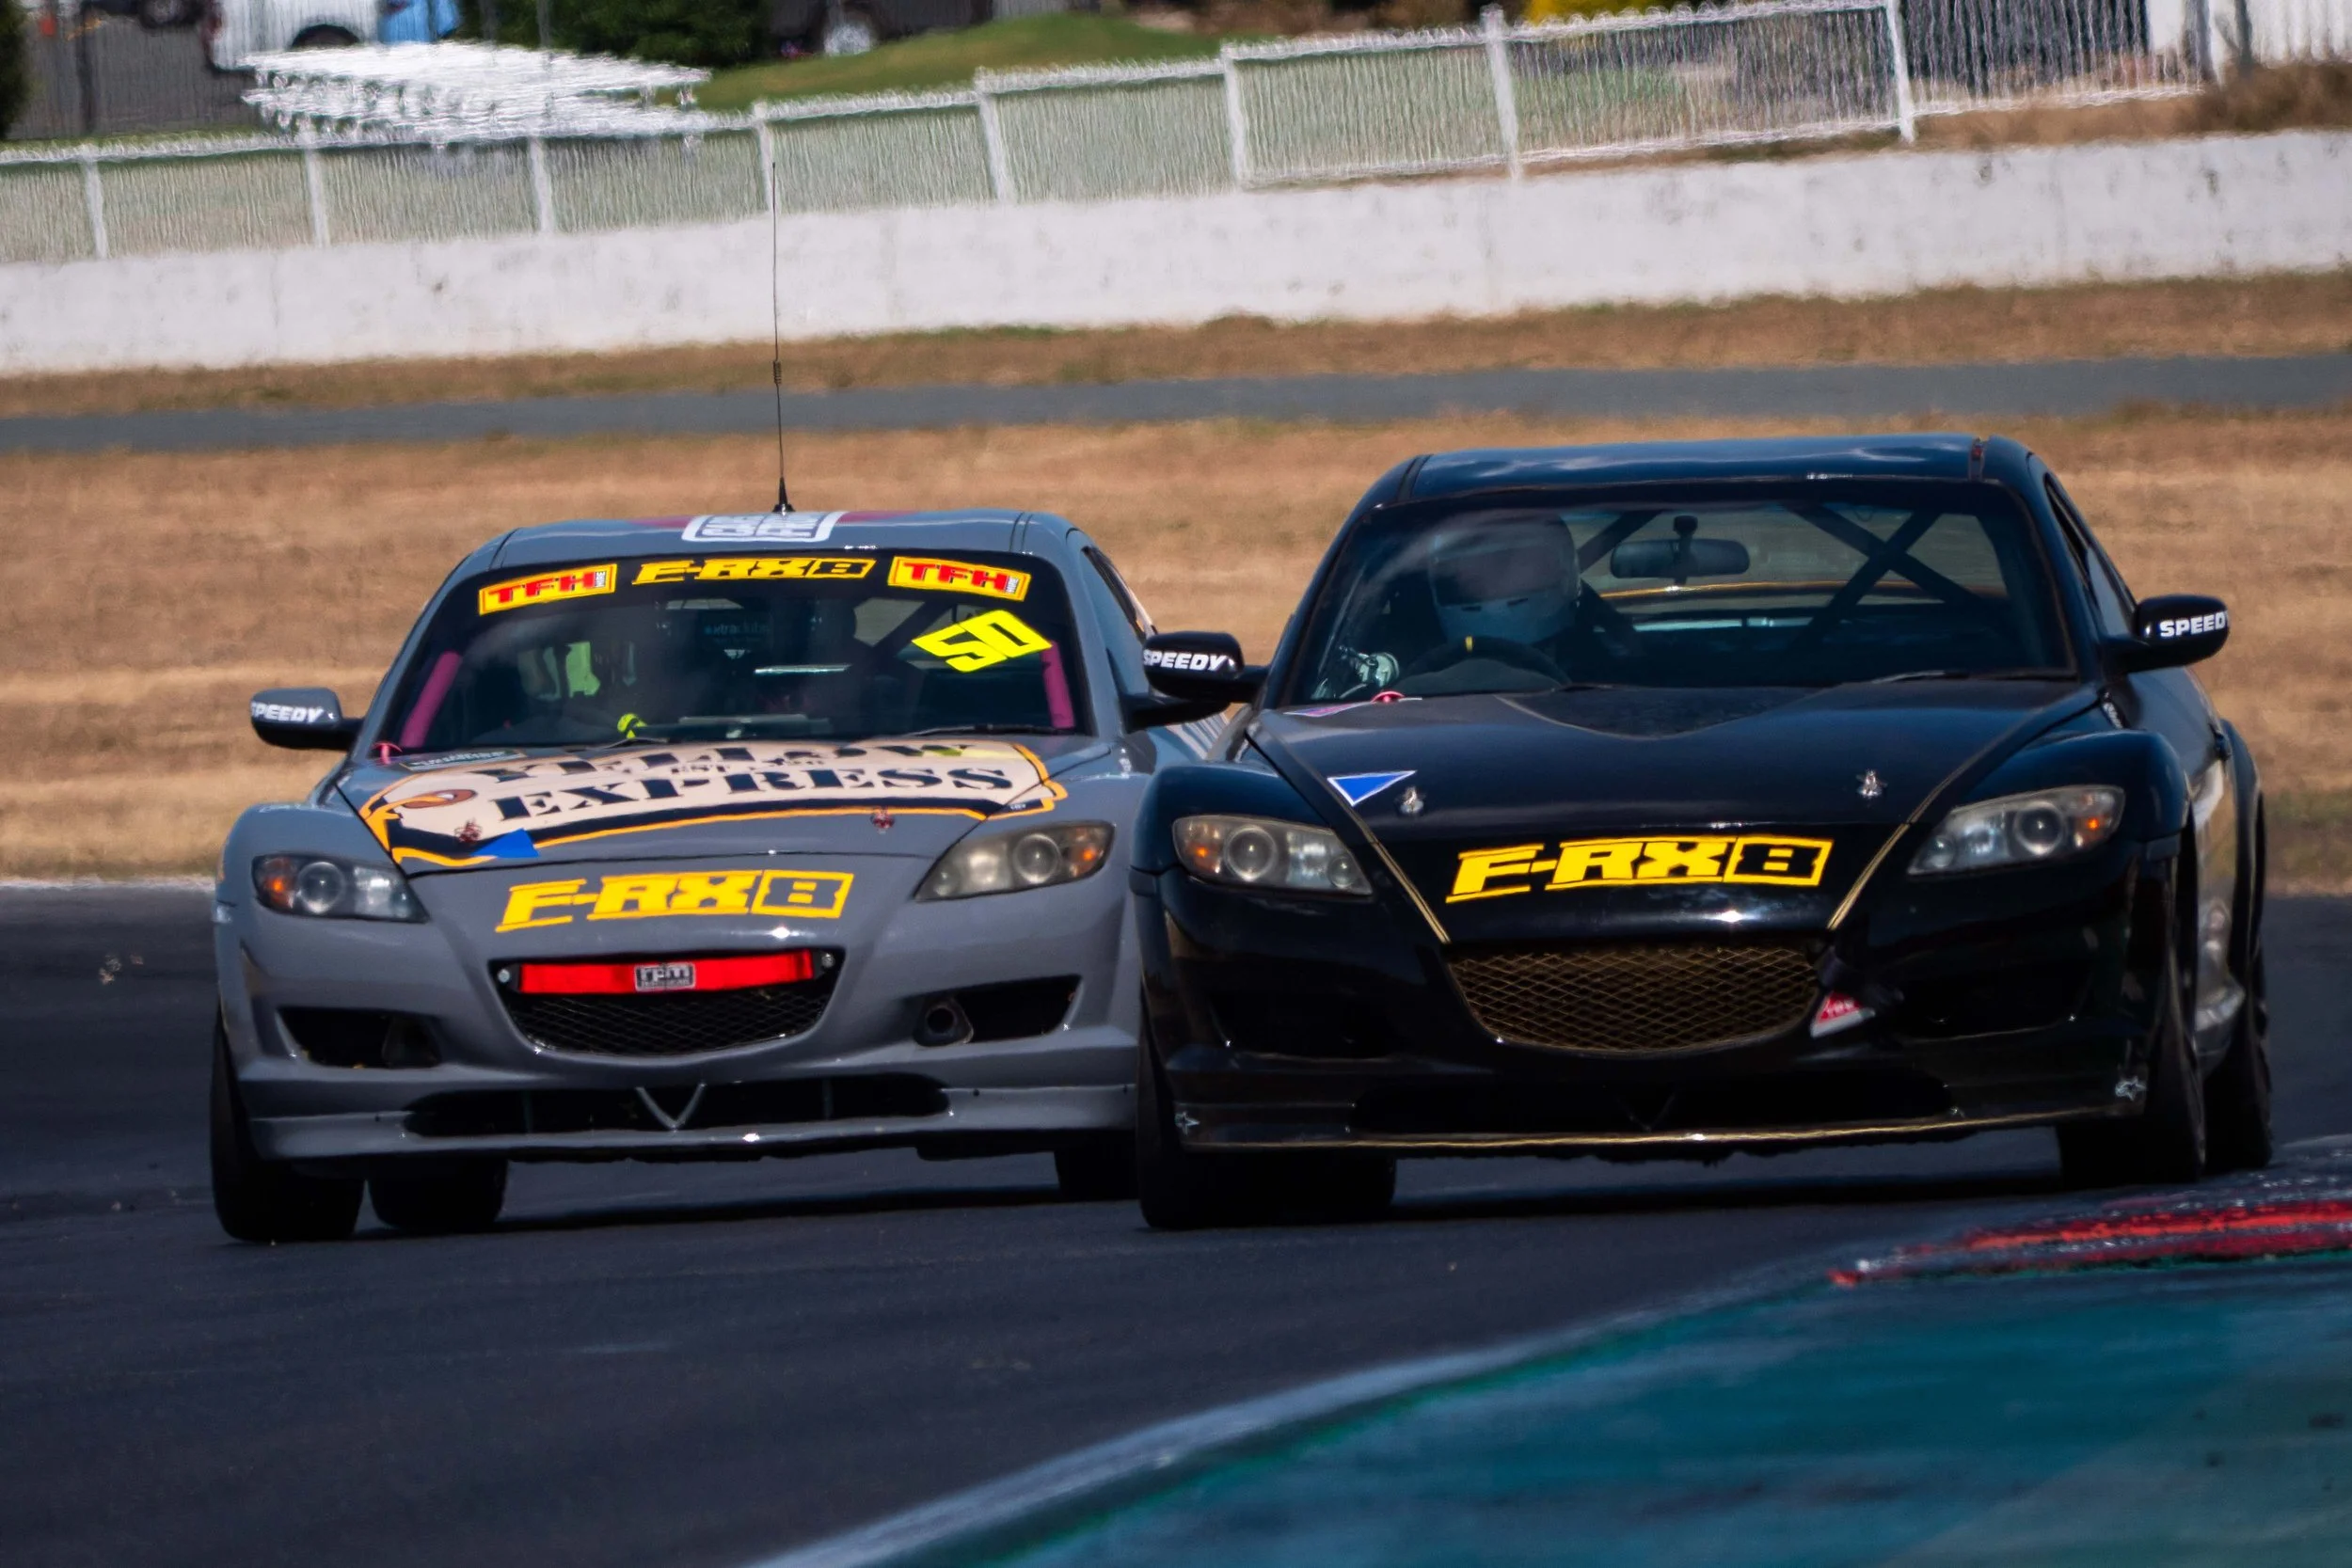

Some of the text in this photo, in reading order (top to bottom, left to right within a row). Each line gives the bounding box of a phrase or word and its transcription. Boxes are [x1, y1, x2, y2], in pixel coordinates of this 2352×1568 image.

[488, 571, 596, 603] TFH
[903, 562, 1009, 593] TFH
[2160, 611, 2228, 638] SPEED
[912, 610, 1053, 673] 50
[1143, 649, 1227, 672] SPEEDY
[488, 768, 1013, 821] EXPRESS
[640, 966, 691, 982] rpm
